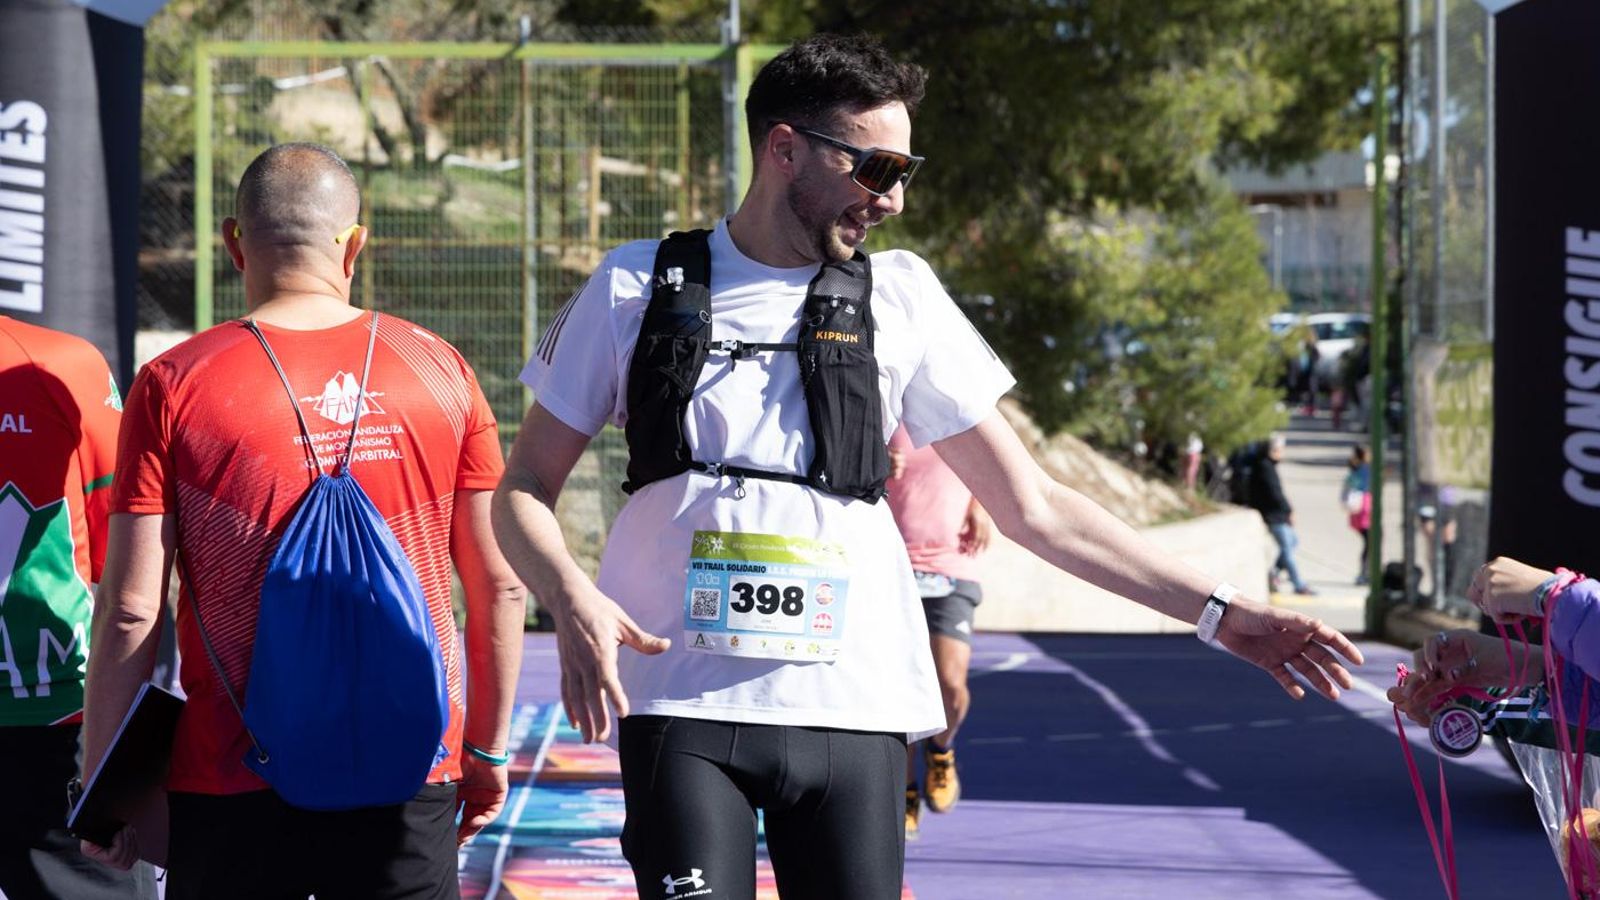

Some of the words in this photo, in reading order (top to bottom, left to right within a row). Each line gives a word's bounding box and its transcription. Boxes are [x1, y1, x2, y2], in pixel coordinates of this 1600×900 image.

[816, 331, 858, 343] KIPRUN
[355, 425, 404, 436] ANDALUZA
[326, 437, 392, 452] MONAÑISMO
[353, 449, 404, 462] ARBITRAL
[692, 562, 702, 570] VII
[704, 562, 725, 571] TRAIL
[726, 563, 767, 574] SOLIDARIO
[730, 582, 804, 616] 398
